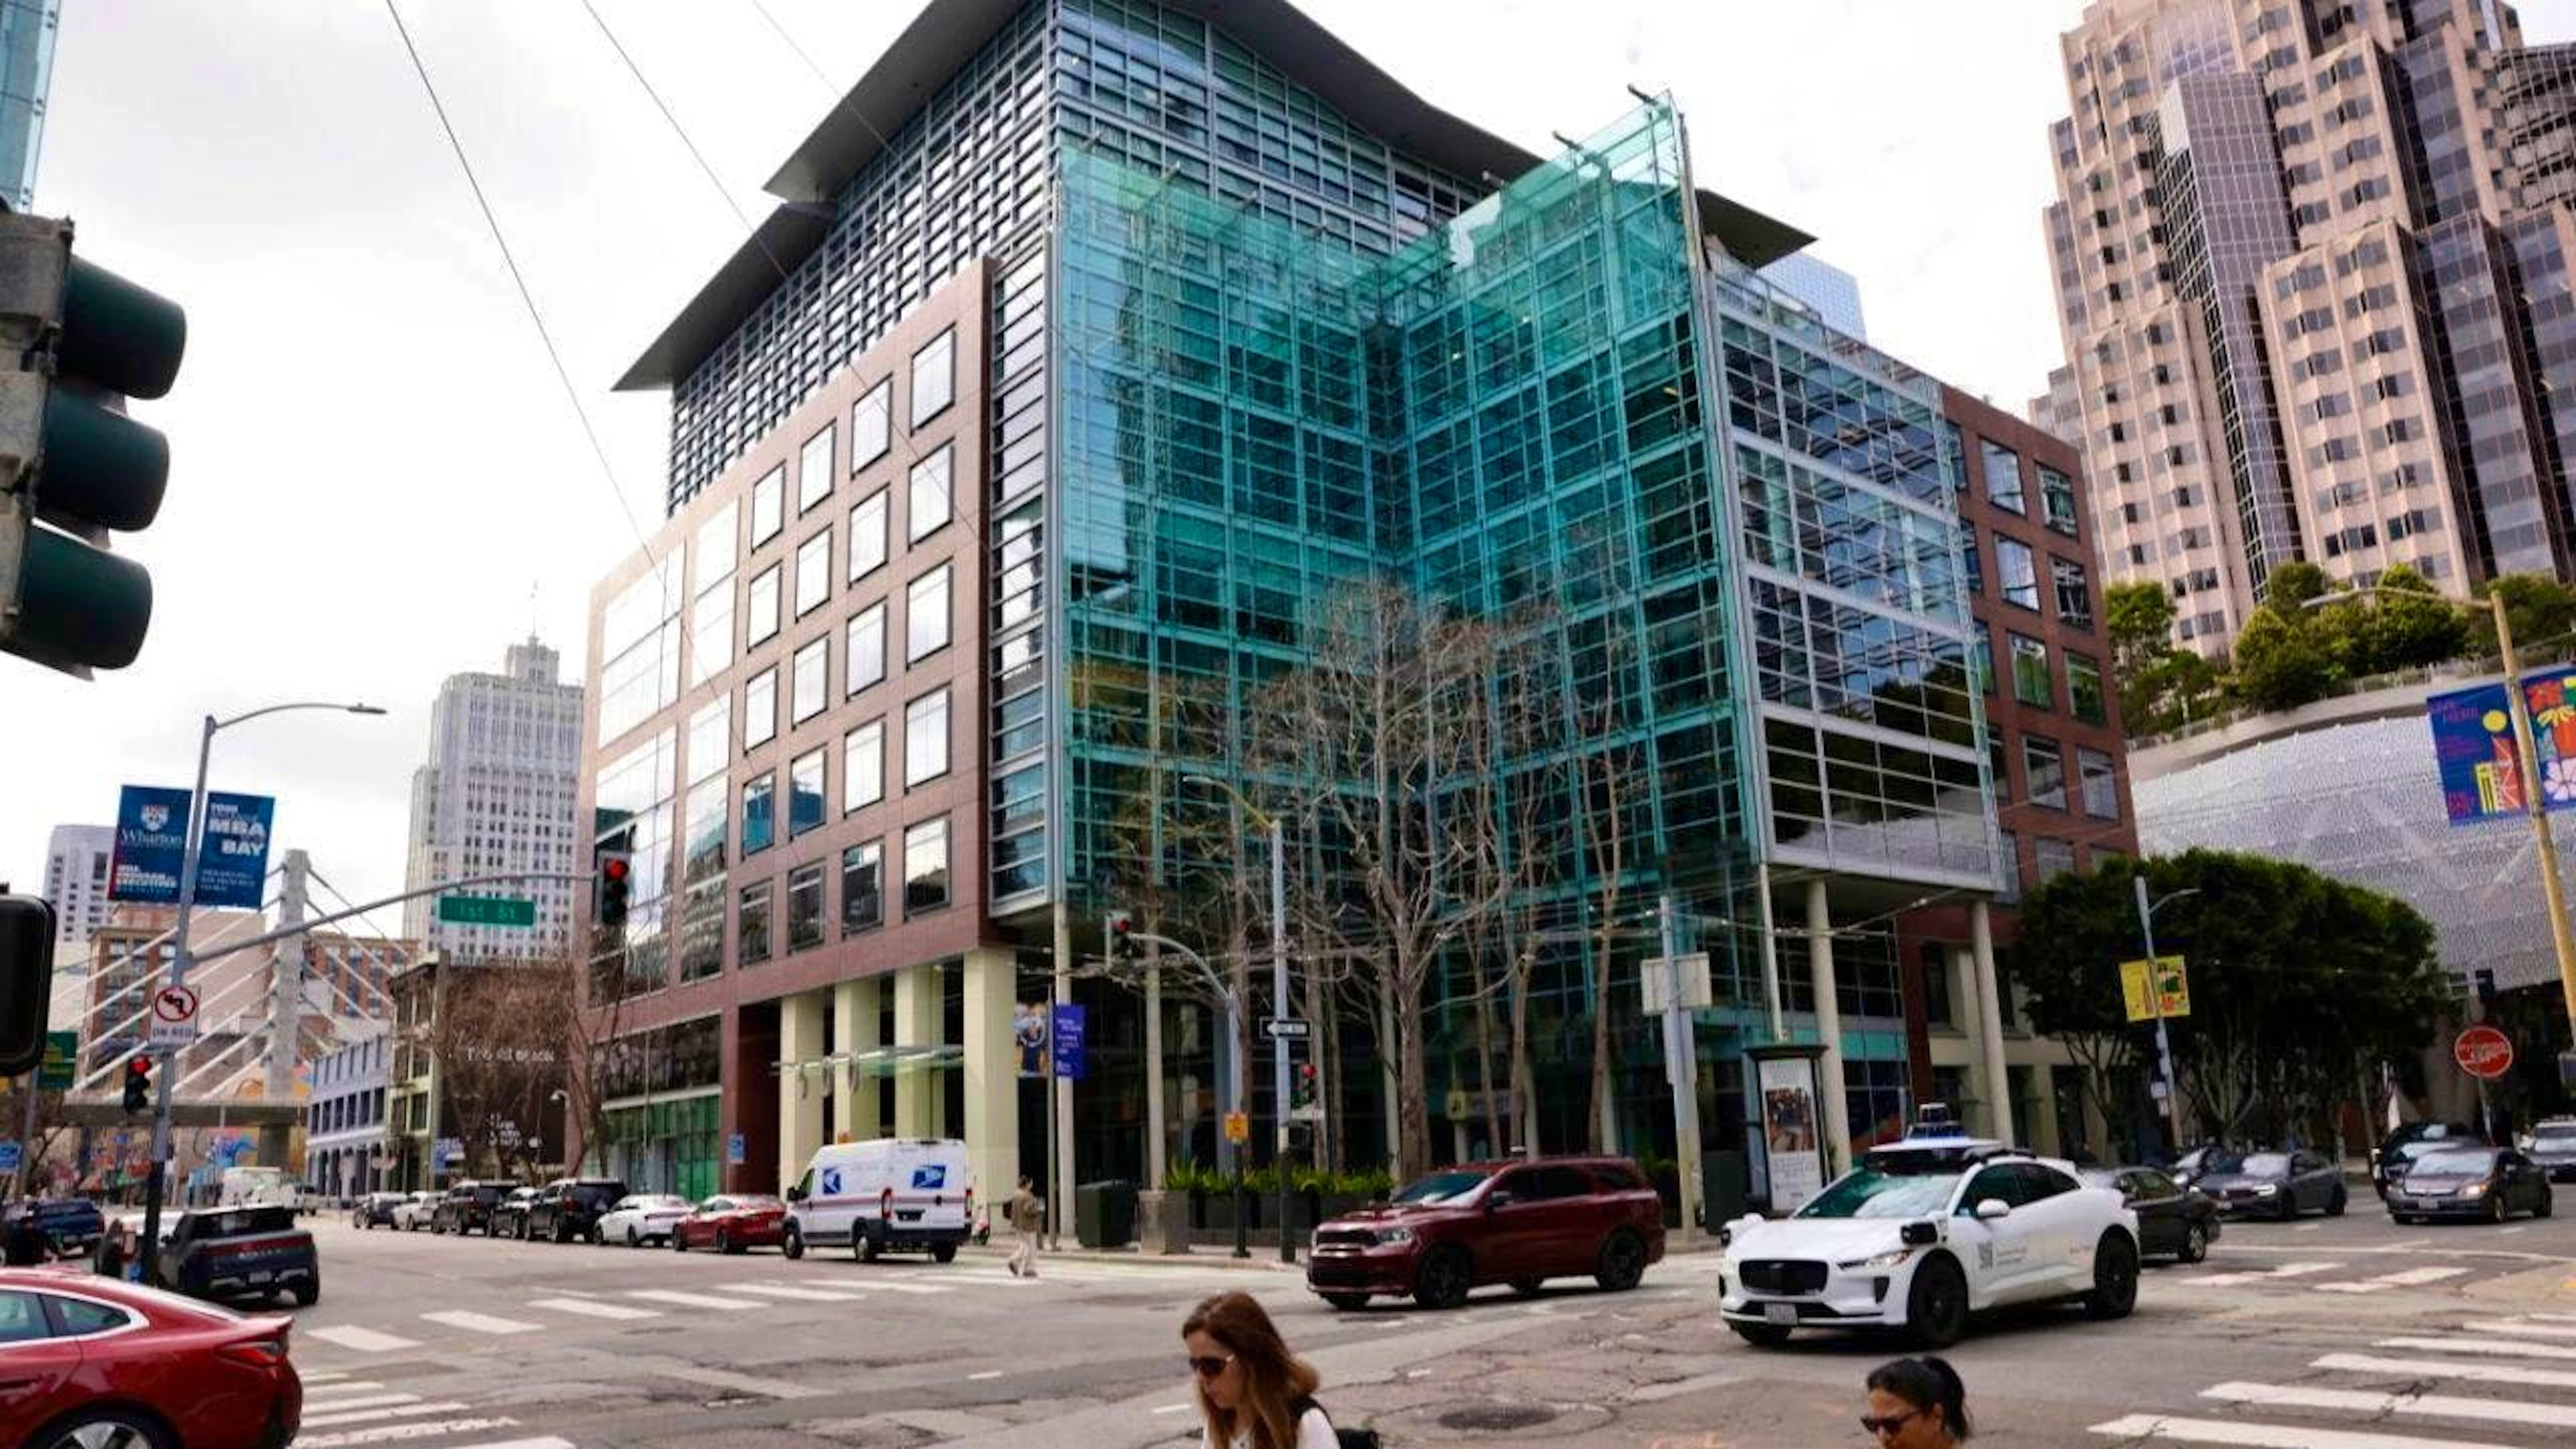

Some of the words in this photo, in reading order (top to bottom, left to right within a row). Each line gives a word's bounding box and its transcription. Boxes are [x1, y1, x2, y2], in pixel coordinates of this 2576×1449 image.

[121, 827, 183, 845] Wharton
[208, 818, 266, 837] MBA
[221, 839, 265, 856] BAY
